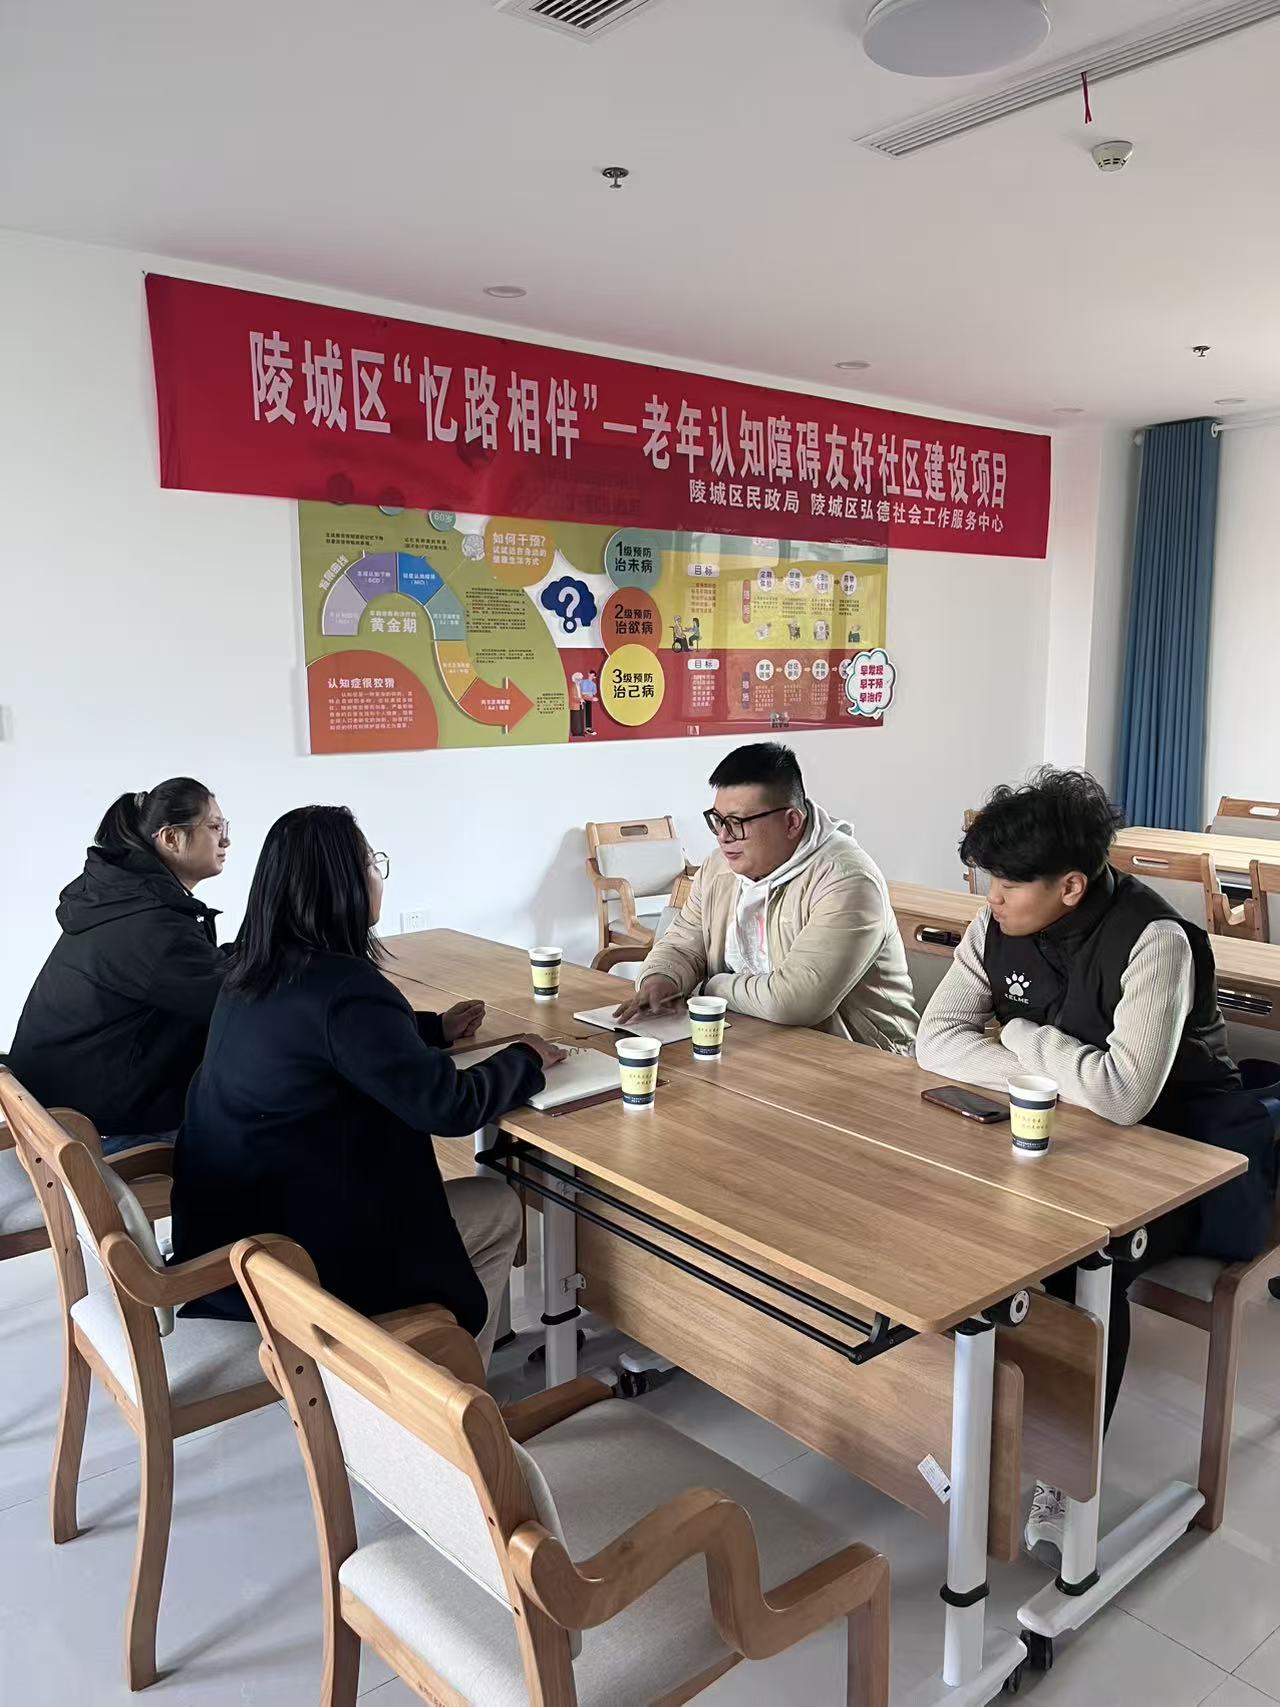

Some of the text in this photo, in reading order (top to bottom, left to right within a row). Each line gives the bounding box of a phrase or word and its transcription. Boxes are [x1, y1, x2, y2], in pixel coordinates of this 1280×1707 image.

[689, 479, 1004, 533] 陵城区民政局 陵城区弘德社会工作服务中心
[615, 541, 652, 558] 1级预防
[615, 558, 653, 573] 治未病
[694, 565, 713, 576] 目标
[614, 604, 652, 619] 2级预防
[370, 617, 417, 633] 黄金期
[694, 660, 713, 669] 目标
[860, 664, 884, 676] 早发现
[612, 669, 653, 684] 3级预防
[327, 678, 395, 689] 认知症很狡猾
[859, 678, 884, 690] 早干预
[859, 691, 883, 703] 早治疗
[1004, 993, 1030, 1005] KELME
